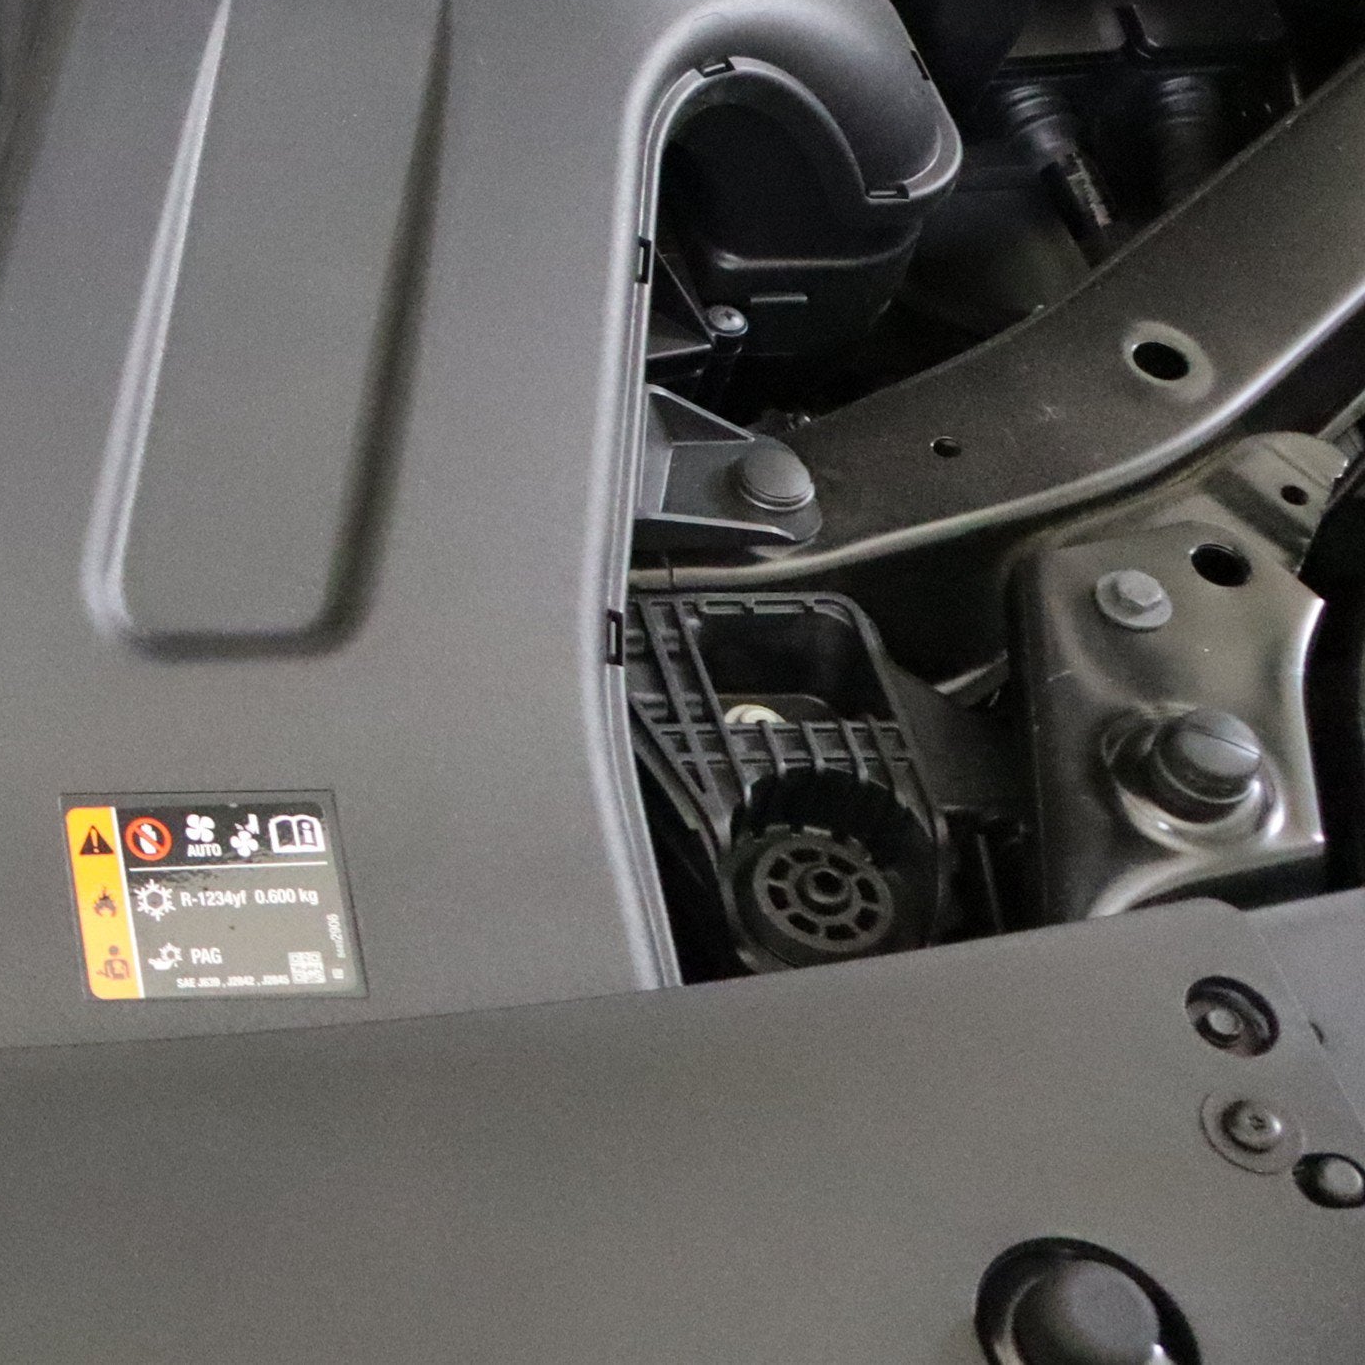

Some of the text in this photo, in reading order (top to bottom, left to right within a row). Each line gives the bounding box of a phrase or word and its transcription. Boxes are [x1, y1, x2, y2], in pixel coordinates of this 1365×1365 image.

[186, 843, 222, 857] AUTO
[180, 888, 319, 908] R-1234yf 0.600 kg
[191, 947, 223, 964] PAG
